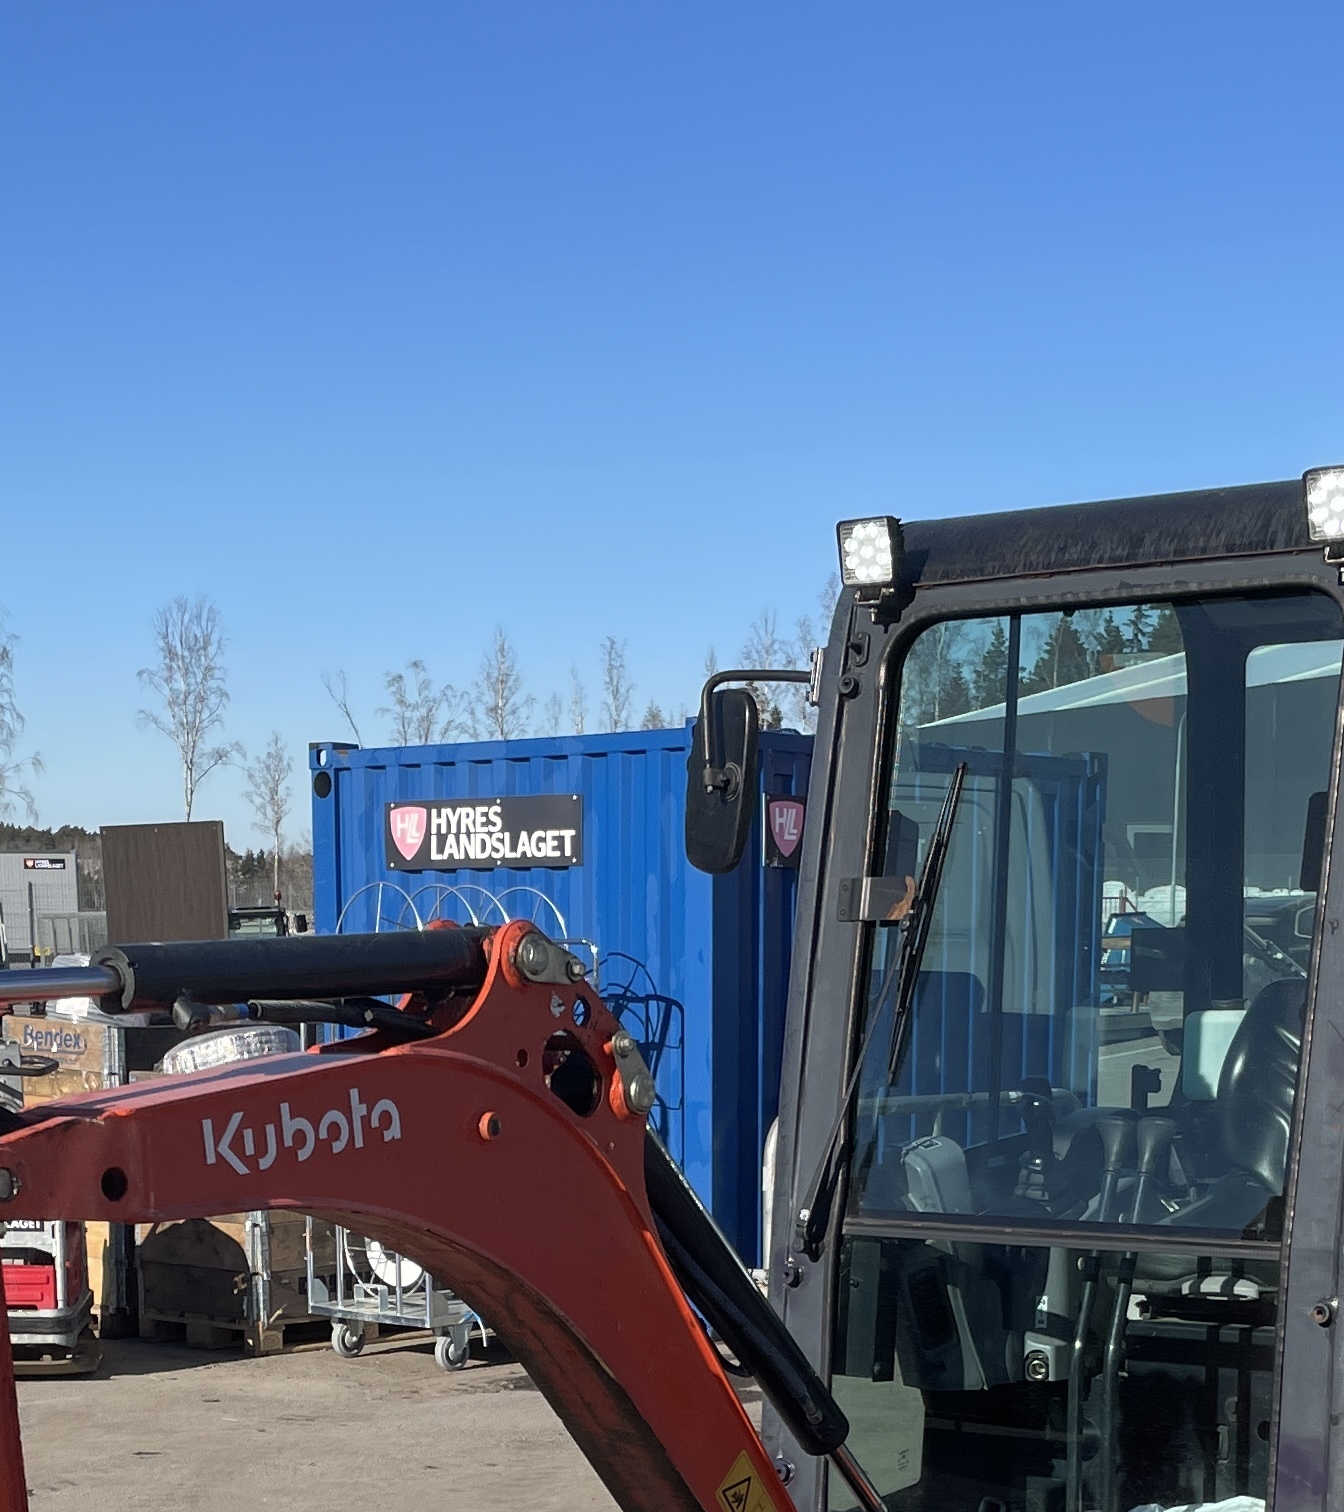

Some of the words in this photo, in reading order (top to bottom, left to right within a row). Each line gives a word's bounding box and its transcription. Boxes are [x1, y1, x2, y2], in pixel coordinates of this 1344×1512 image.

[431, 806, 502, 834] HYRES
[431, 829, 576, 861] LANDSLAGET
[201, 1087, 402, 1176] Kubota
